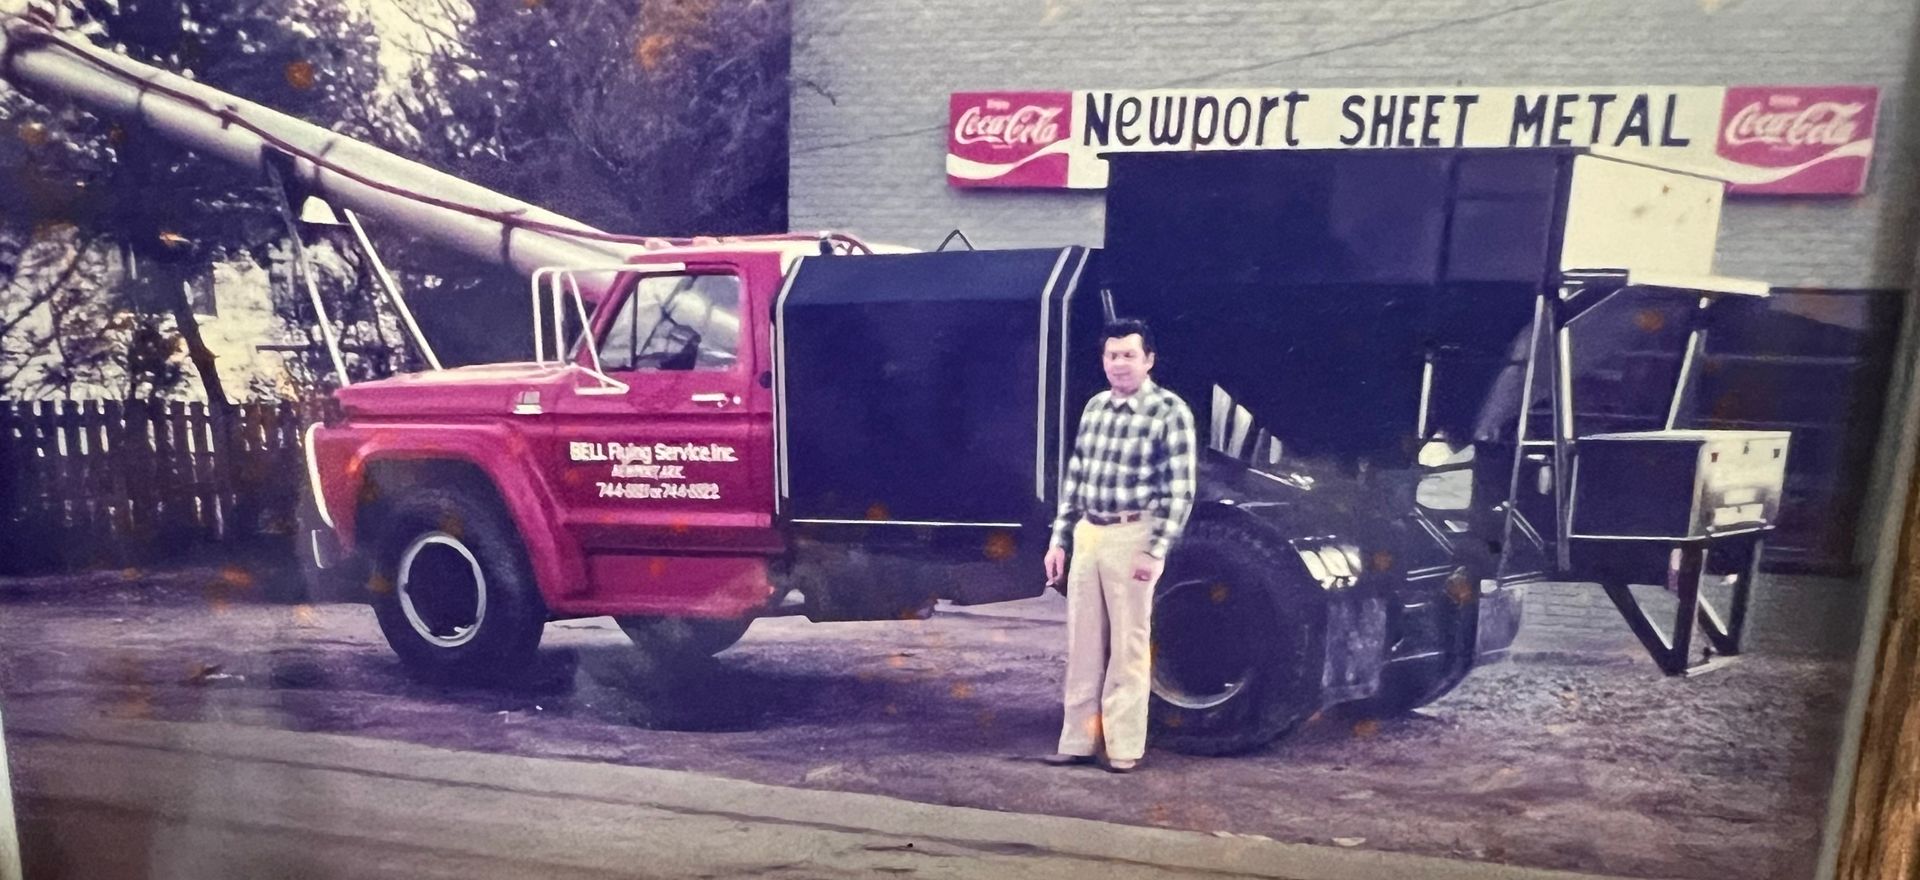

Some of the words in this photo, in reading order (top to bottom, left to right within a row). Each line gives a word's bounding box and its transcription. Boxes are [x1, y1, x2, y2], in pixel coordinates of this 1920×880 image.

[1083, 91, 1309, 150] Newport
[1340, 94, 1479, 147] SHEET
[1509, 93, 1690, 147] METAL
[570, 441, 607, 461] BELL
[607, 442, 652, 466] Flying
